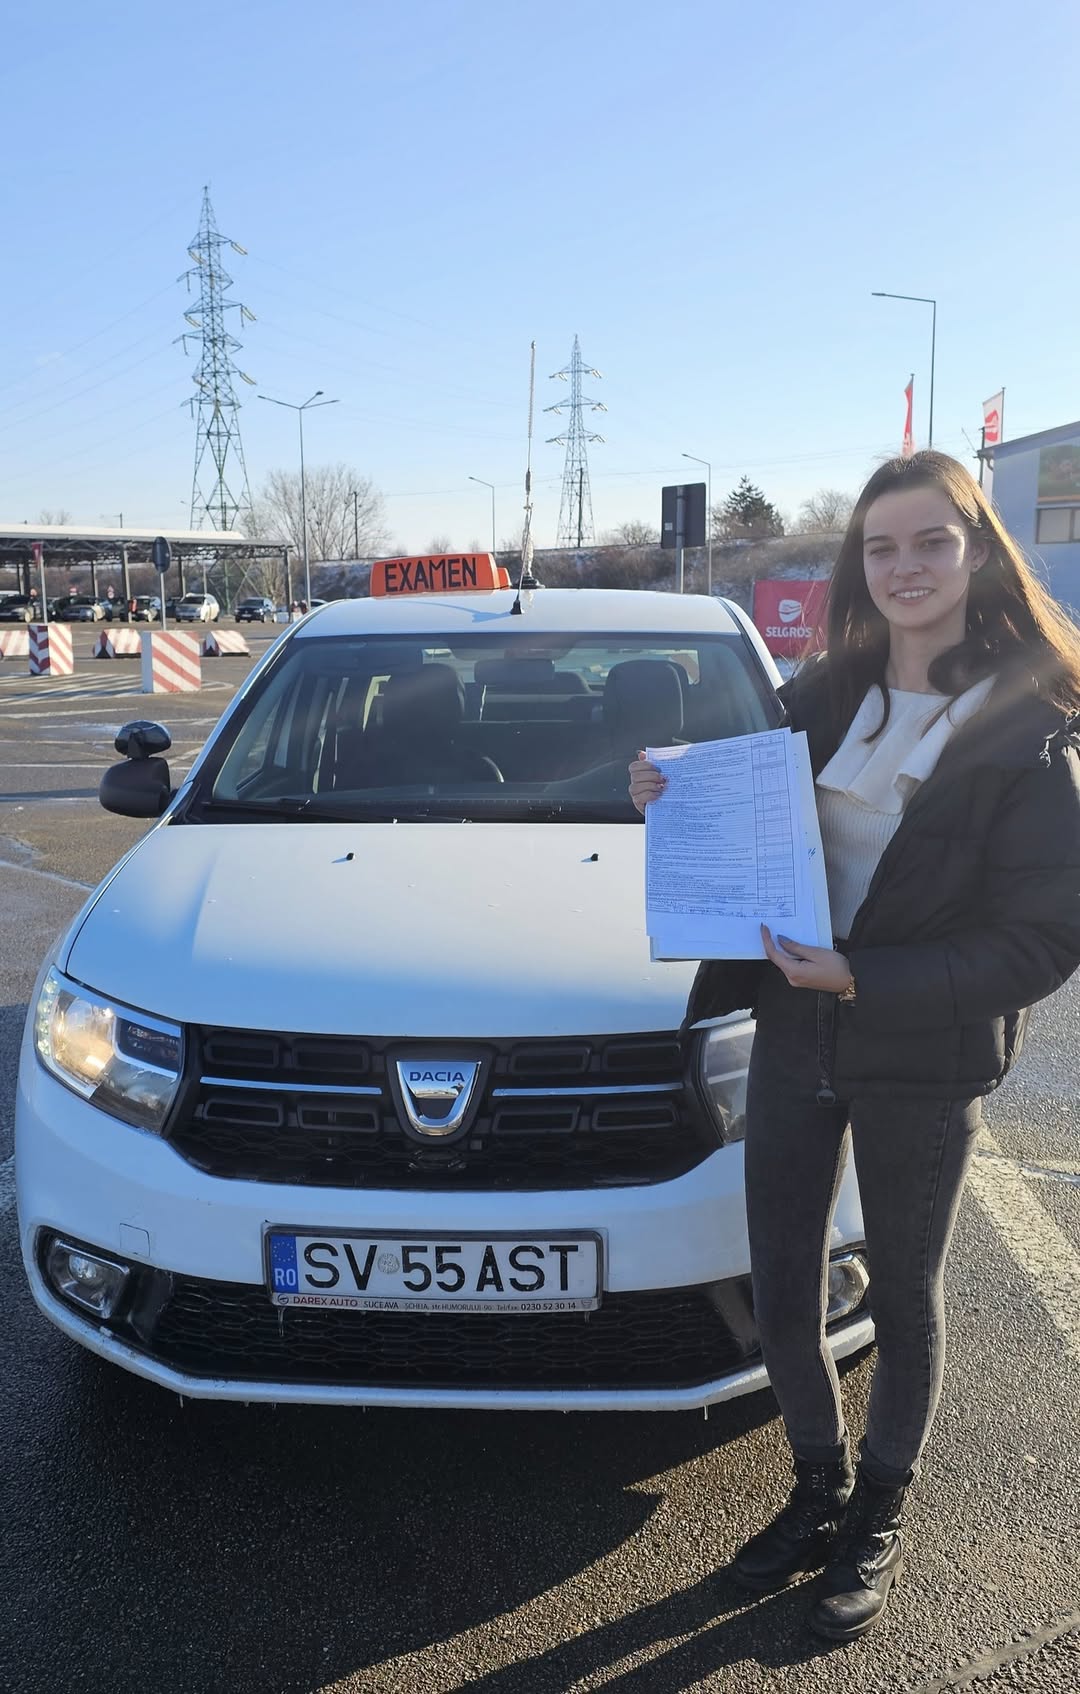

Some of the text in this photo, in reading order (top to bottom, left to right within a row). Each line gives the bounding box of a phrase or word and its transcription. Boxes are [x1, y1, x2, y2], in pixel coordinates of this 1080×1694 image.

[384, 557, 477, 593] EXAMEN
[765, 626, 813, 638] SELGROS
[409, 1071, 465, 1082] DACIA
[303, 1242, 378, 1291] SV
[402, 1245, 466, 1292] 55
[476, 1245, 579, 1292] AST
[275, 1268, 296, 1287] RO
[293, 1296, 327, 1306] DAREX
[329, 1298, 358, 1307] AUTO
[363, 1301, 399, 1310] SUCEAVA
[520, 1303, 542, 1311] 0230
[542, 1303, 553, 1311] 52
[554, 1302, 565, 1310] 30
[567, 1302, 576, 1310] 14
